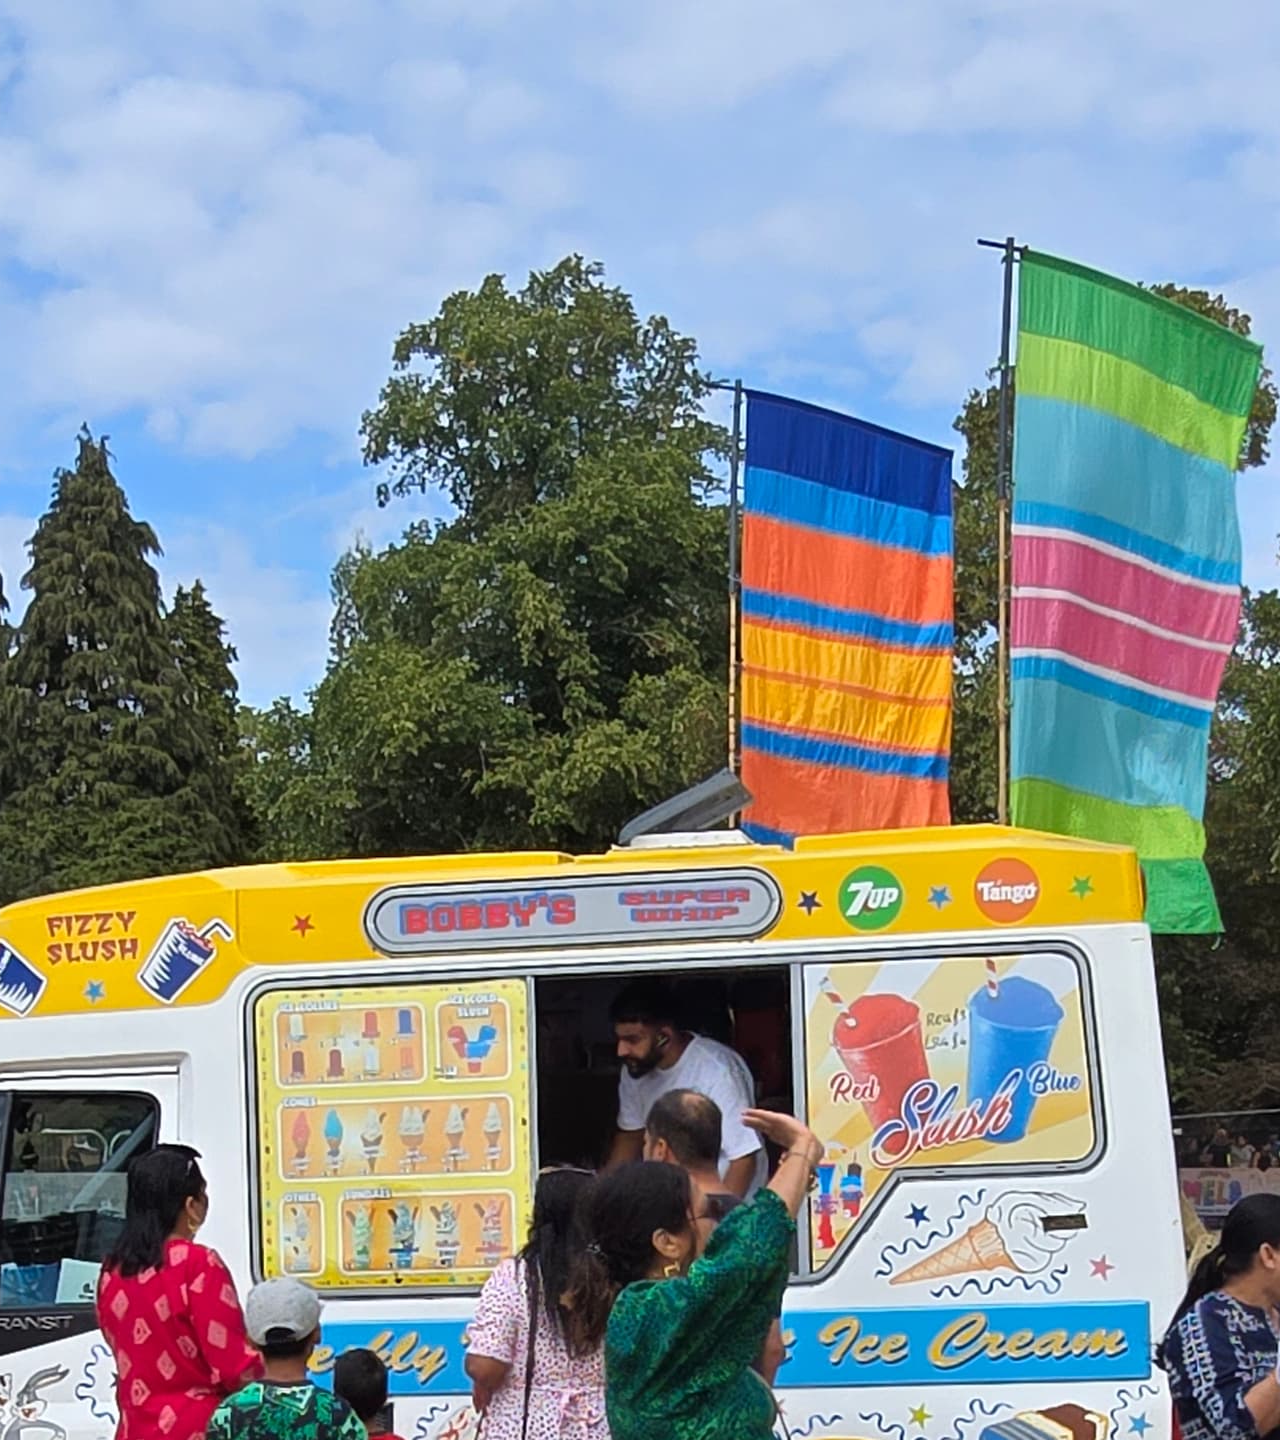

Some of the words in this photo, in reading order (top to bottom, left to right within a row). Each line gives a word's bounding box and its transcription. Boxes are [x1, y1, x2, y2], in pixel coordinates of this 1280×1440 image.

[617, 886, 751, 906] SUPER
[846, 881, 899, 917] 7UP
[977, 880, 1037, 904] Tango
[46, 911, 137, 938] FIZZY
[400, 892, 577, 935] BOBBY'S
[631, 906, 740, 924] WHIP
[46, 938, 139, 966] SLUSH
[830, 1073, 880, 1104] Red
[1027, 1061, 1080, 1095] Blue
[870, 1068, 1021, 1169] Slush
[818, 1315, 909, 1365] Ice
[927, 1311, 1128, 1370] Cream
